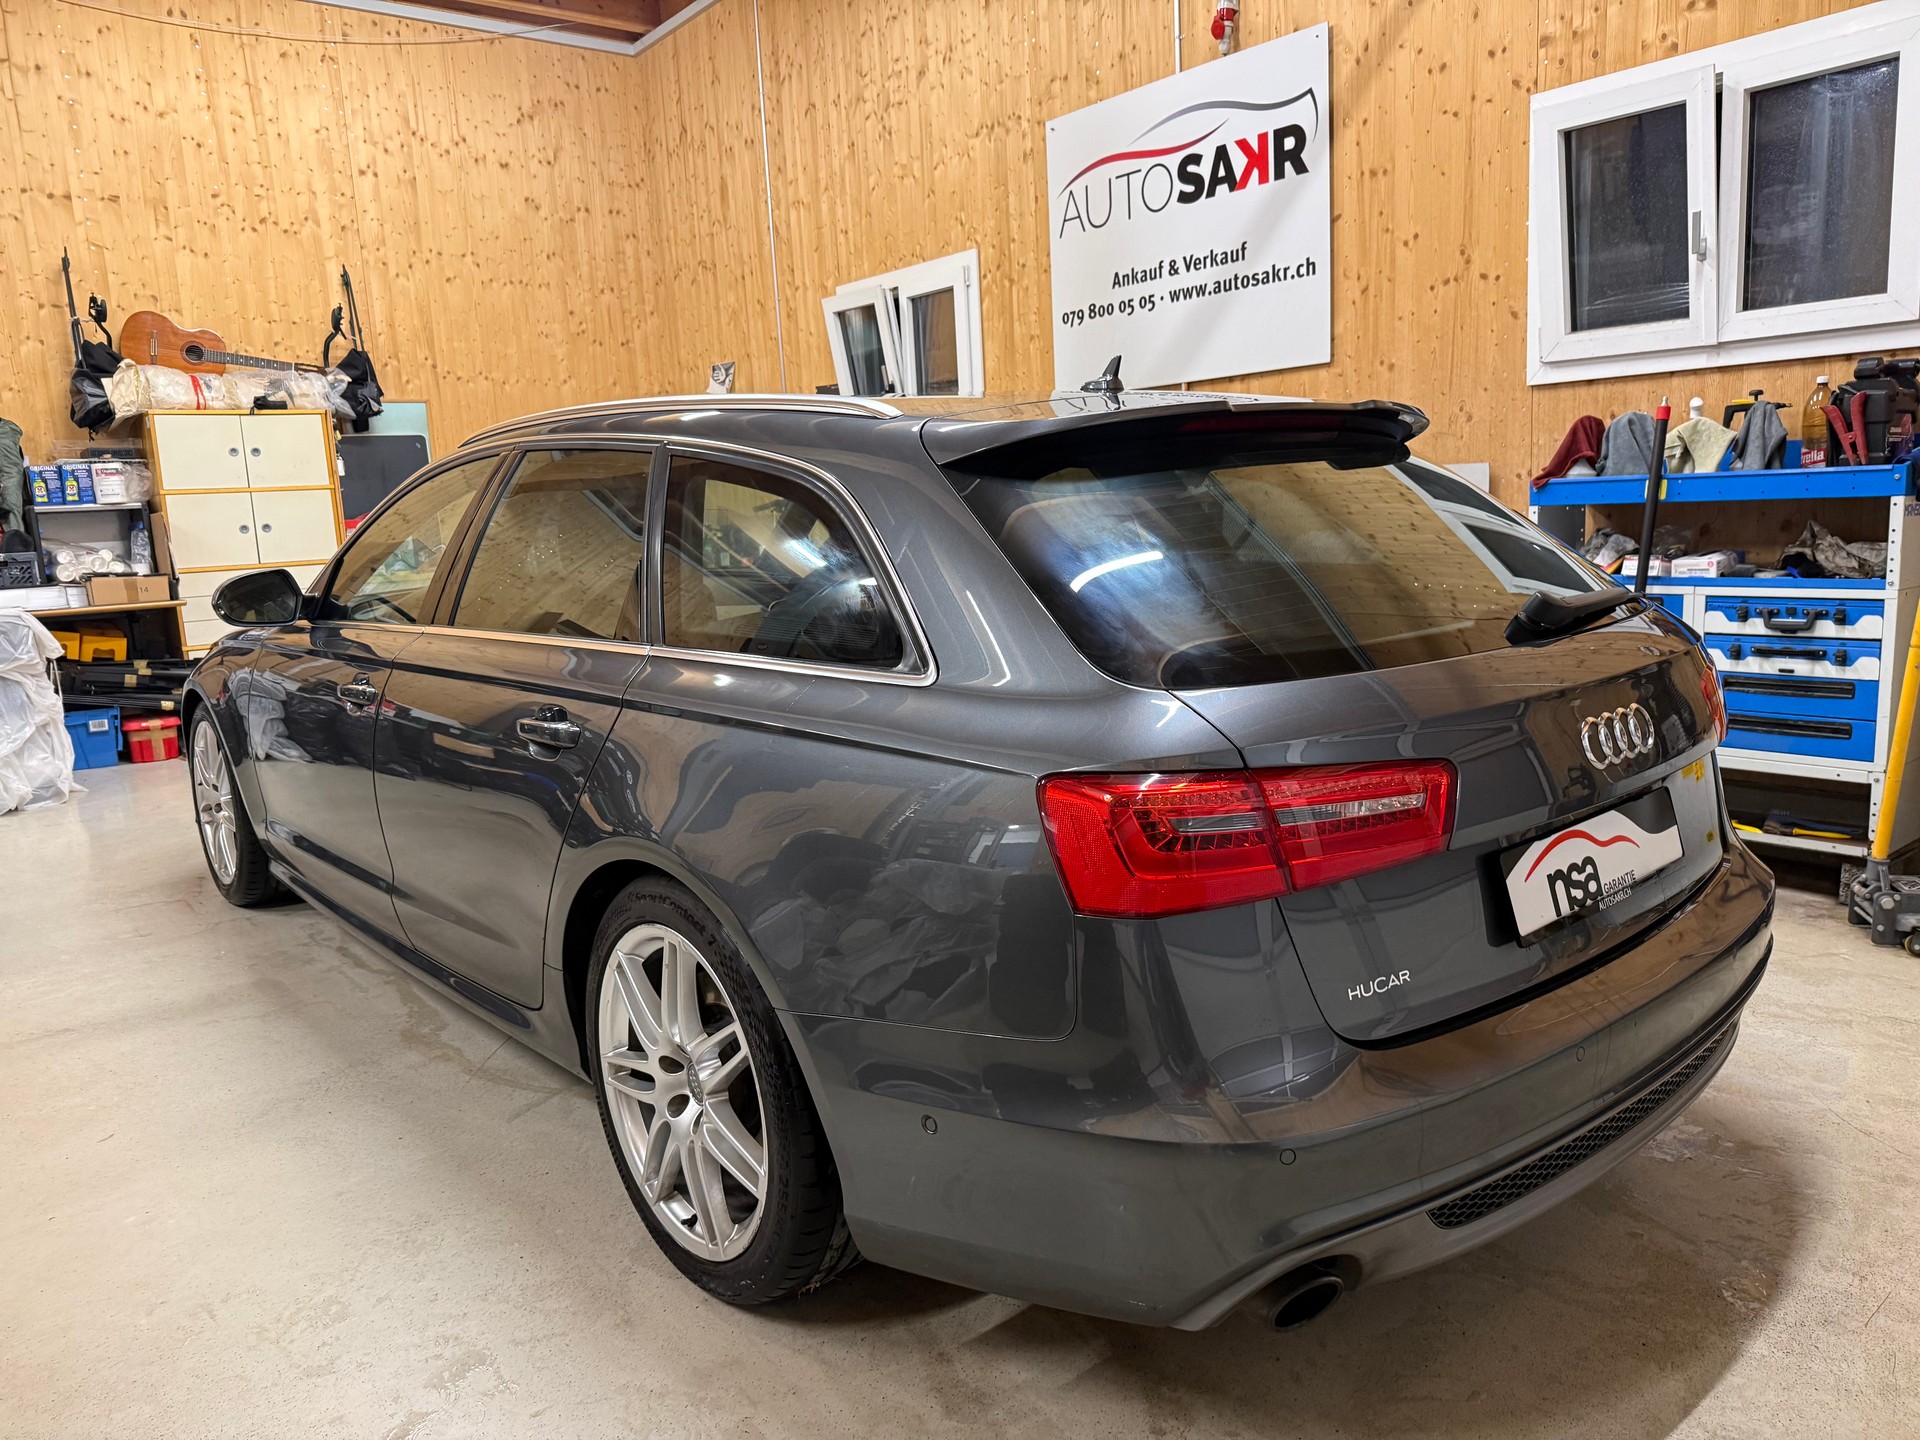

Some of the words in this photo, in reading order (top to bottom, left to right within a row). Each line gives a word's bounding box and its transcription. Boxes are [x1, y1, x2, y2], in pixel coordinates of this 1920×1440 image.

[1059, 123, 1310, 239] AUTOSAKR
[1062, 309, 1085, 328] 079
[1088, 302, 1115, 320] 800
[1118, 298, 1135, 316] 05
[1139, 294, 1156, 312] 05
[1169, 257, 1316, 303] www.autosakr.ch
[1112, 260, 1164, 290] Ankauf
[1168, 259, 1180, 277] &
[1182, 241, 1248, 273] Verkauf
[1546, 856, 1604, 918] nsa
[1603, 869, 1636, 894] GARANTIE
[1347, 969, 1411, 1001] HUCAR
